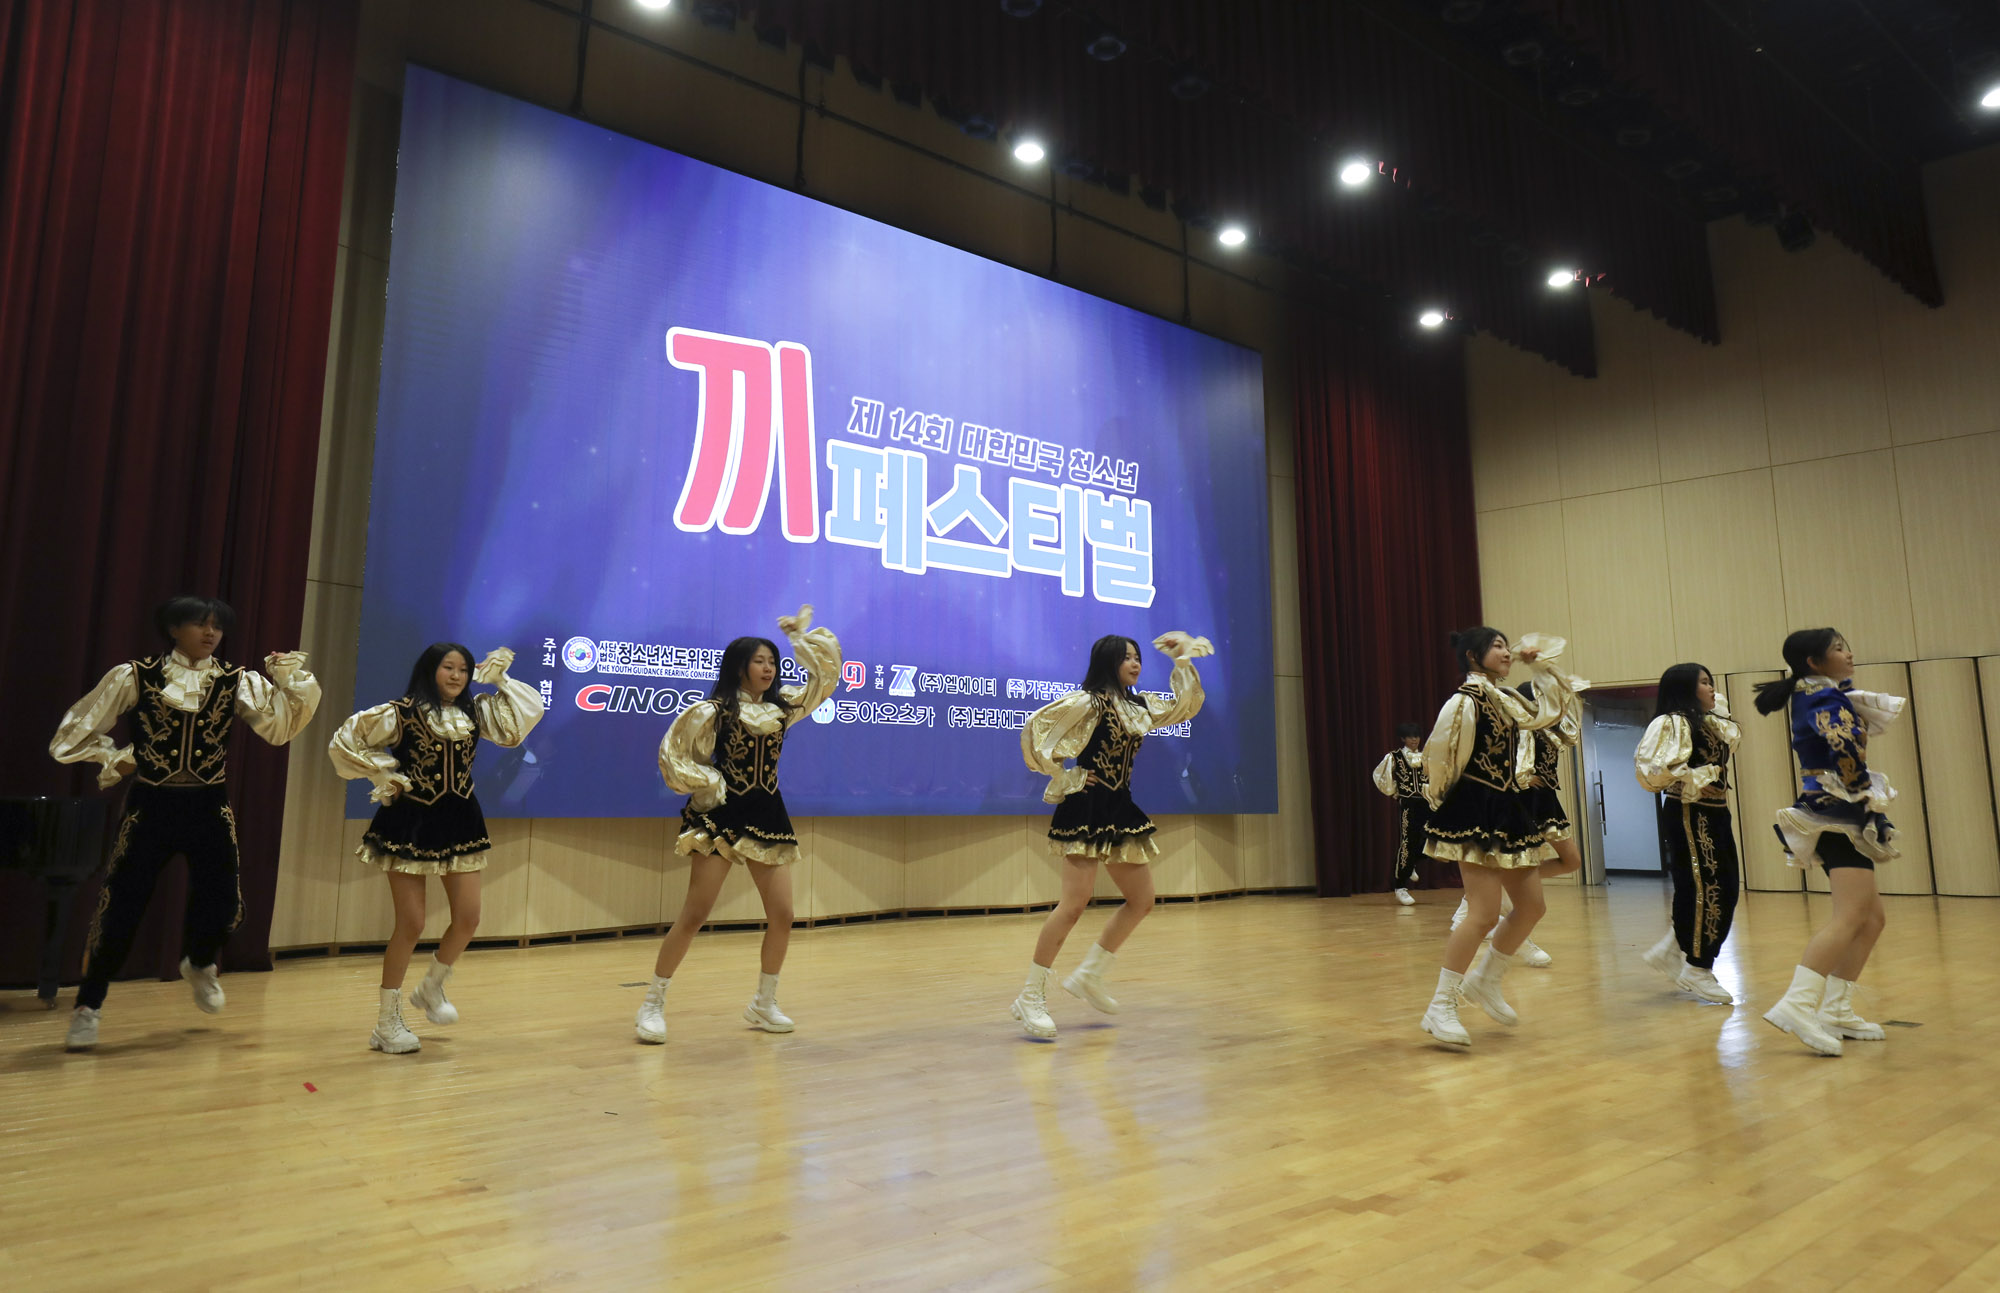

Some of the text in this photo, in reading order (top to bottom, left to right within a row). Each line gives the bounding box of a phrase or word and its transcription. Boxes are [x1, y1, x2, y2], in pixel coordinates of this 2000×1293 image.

[666, 326, 820, 543] 끼
[847, 396, 1139, 494] 제 14회 대한민국 청소년
[825, 438, 1156, 608] 페스티벌
[542, 638, 557, 668] 주최
[599, 641, 618, 653] 사단
[599, 652, 618, 663] 법인
[598, 663, 611, 673] THE
[611, 664, 632, 675] YOUTH
[632, 666, 663, 677] GUIDANCE
[664, 669, 689, 678] REARING
[875, 664, 884, 689] 후원
[919, 672, 997, 697] (주)엘에이티
[836, 700, 936, 727] 동아오츠카
[948, 705, 1035, 730] (주)보라에그
